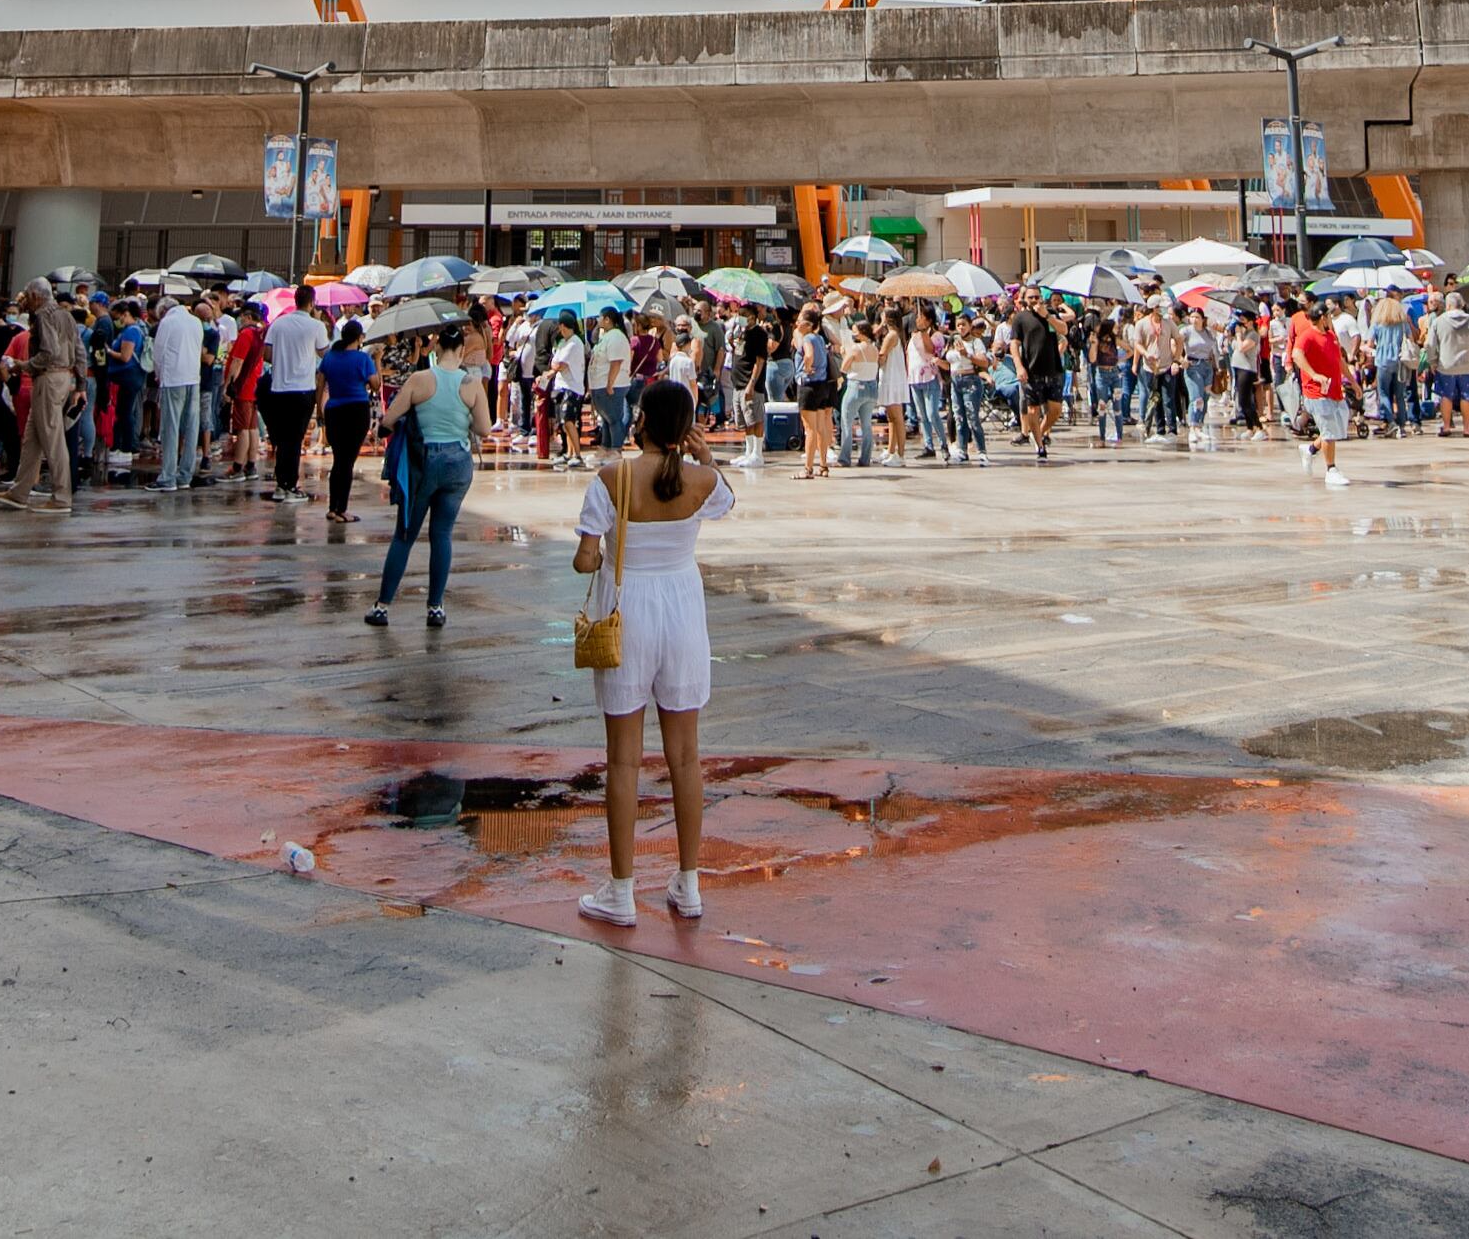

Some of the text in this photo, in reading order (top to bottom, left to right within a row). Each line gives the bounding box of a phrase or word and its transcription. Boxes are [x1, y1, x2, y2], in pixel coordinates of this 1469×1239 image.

[507, 210, 549, 219] ENTRADA
[550, 210, 595, 219] PRINCIPAL
[602, 210, 625, 219] MAIN
[626, 210, 673, 219] ENTRANCE
